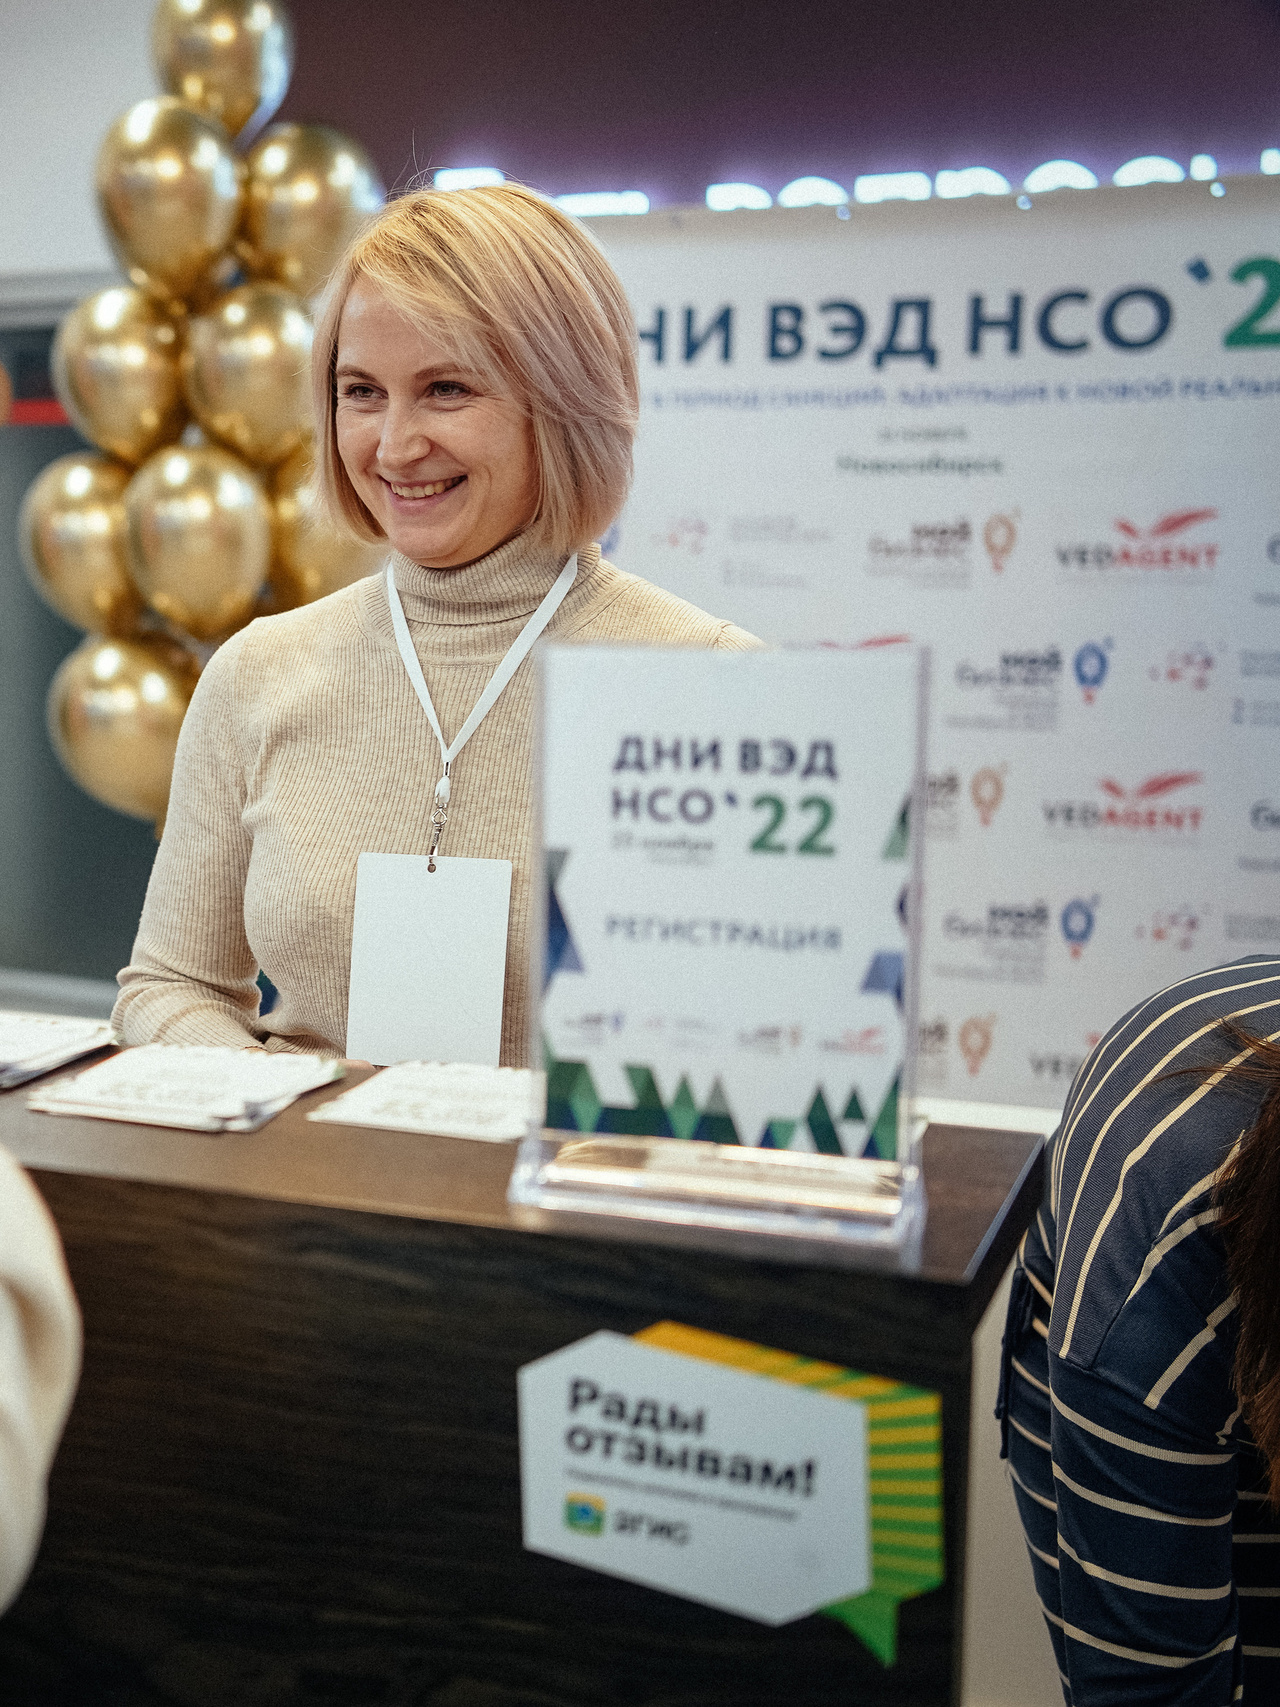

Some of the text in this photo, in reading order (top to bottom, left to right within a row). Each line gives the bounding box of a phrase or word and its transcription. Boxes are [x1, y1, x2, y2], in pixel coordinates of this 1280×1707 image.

[638, 301, 733, 365] НИ
[767, 295, 937, 368] ВЭД
[967, 286, 1173, 356] НСО
[612, 735, 839, 781] ДНИ ВЭД
[610, 788, 715, 827] НСО
[605, 915, 843, 952] РЕГИСТРАЦИЯ
[568, 1376, 705, 1436] Рады
[564, 1424, 818, 1499] отзывам!
